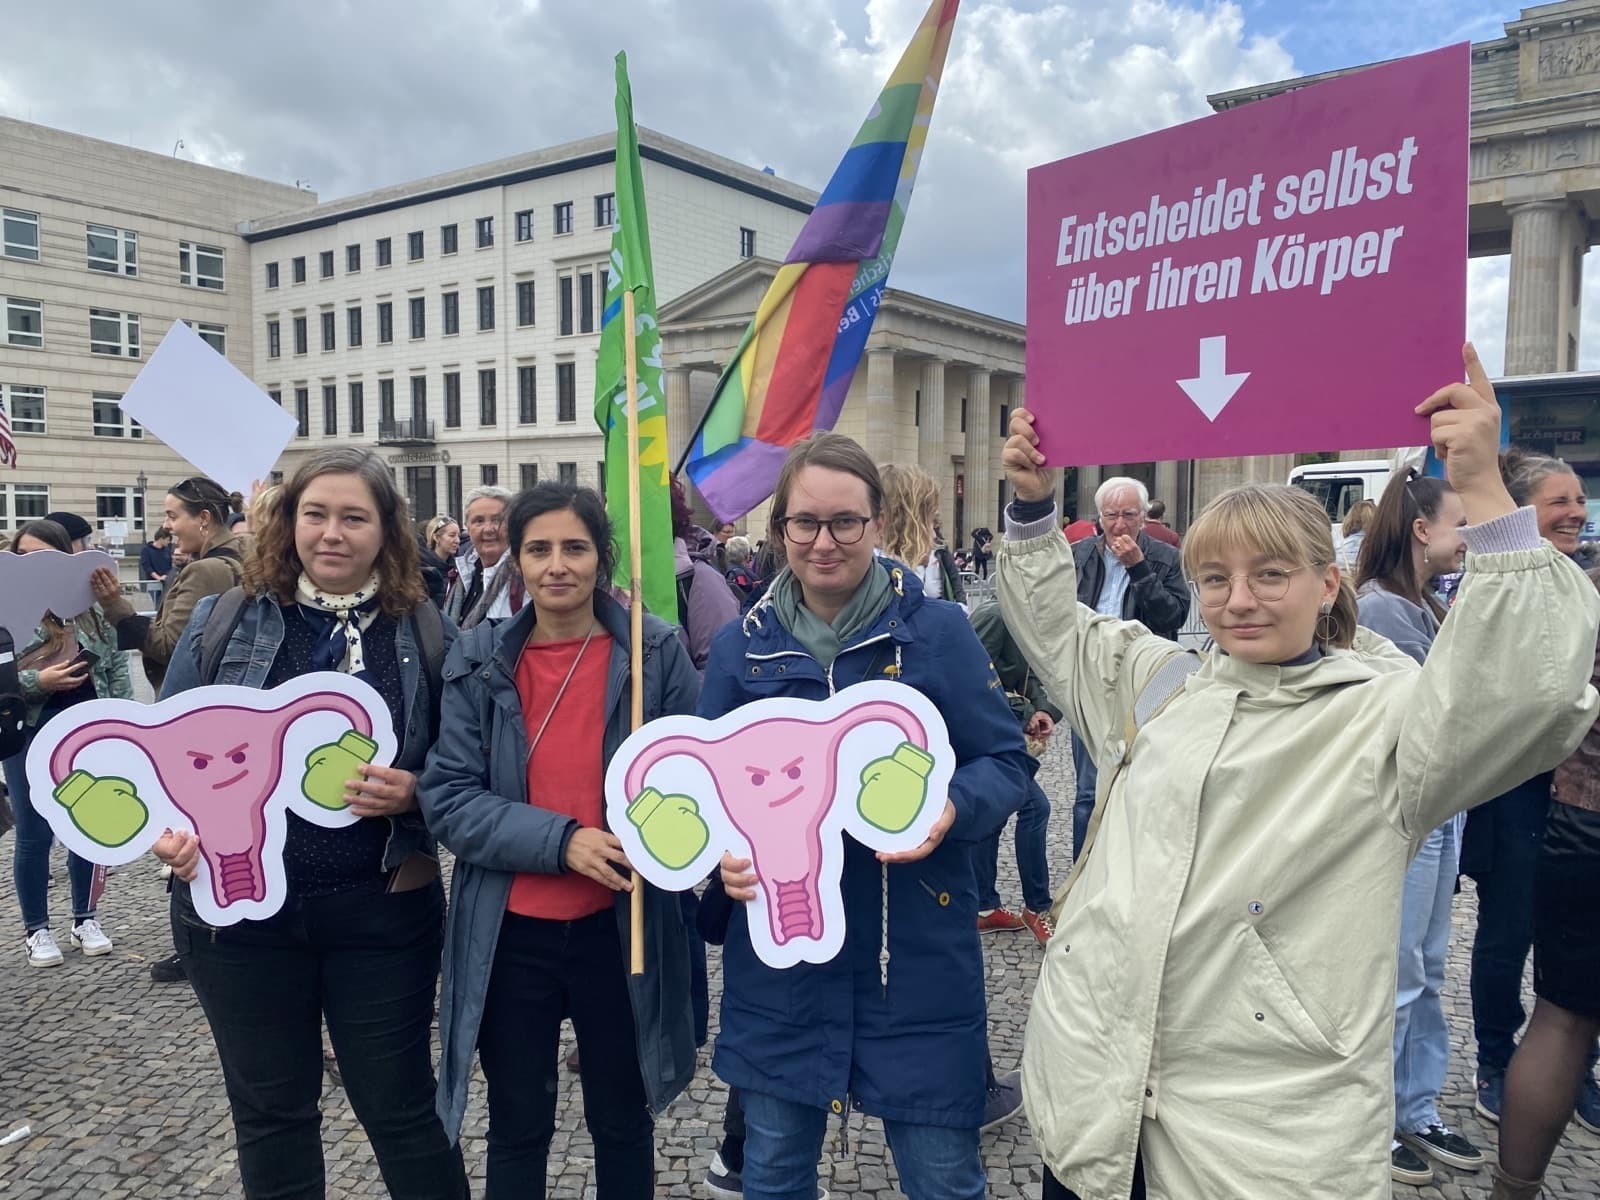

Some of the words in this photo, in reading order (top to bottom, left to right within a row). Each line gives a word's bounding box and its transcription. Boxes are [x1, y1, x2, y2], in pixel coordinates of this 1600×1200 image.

[1056, 173, 1266, 267] Entscheidet
[1273, 136, 1418, 221] selbst
[1064, 271, 1141, 326] über
[1145, 256, 1243, 312] ihren
[1250, 225, 1405, 296] Körper
